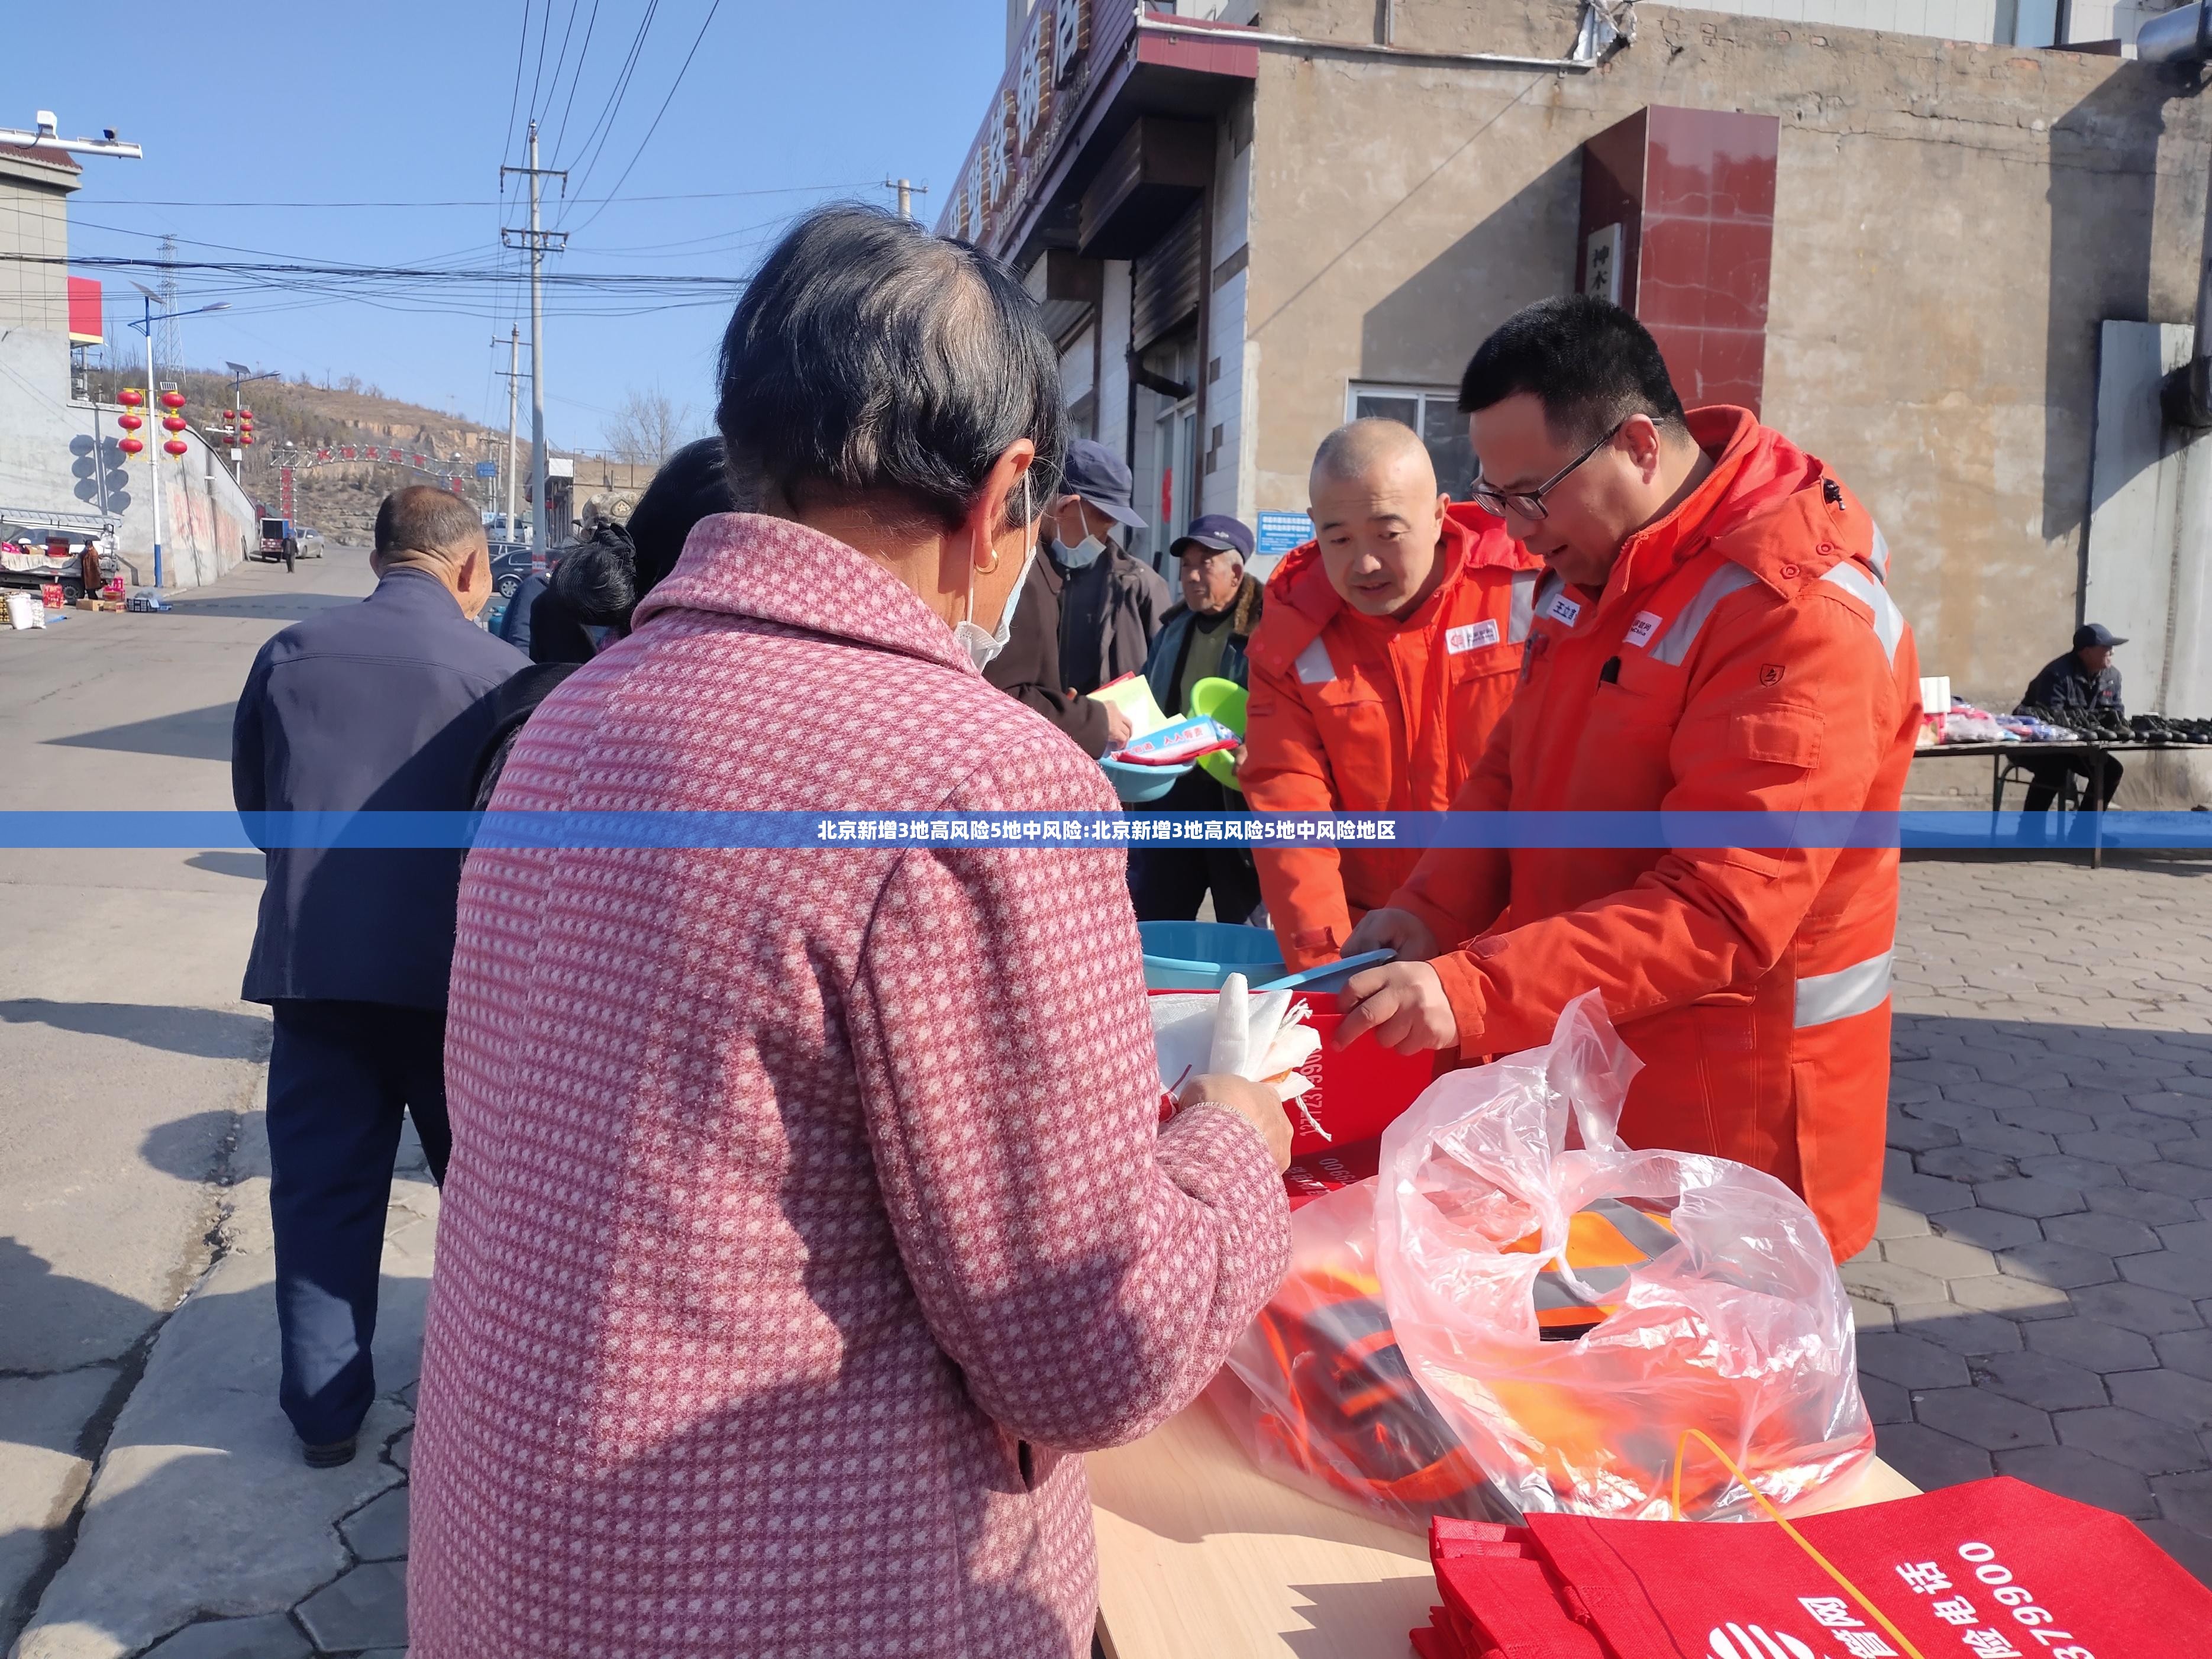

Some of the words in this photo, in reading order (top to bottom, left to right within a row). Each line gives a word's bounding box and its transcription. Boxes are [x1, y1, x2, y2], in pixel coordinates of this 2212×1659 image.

[1797, 1596, 1899, 1659] 管网
[1895, 1561, 2023, 1659] 险电话
